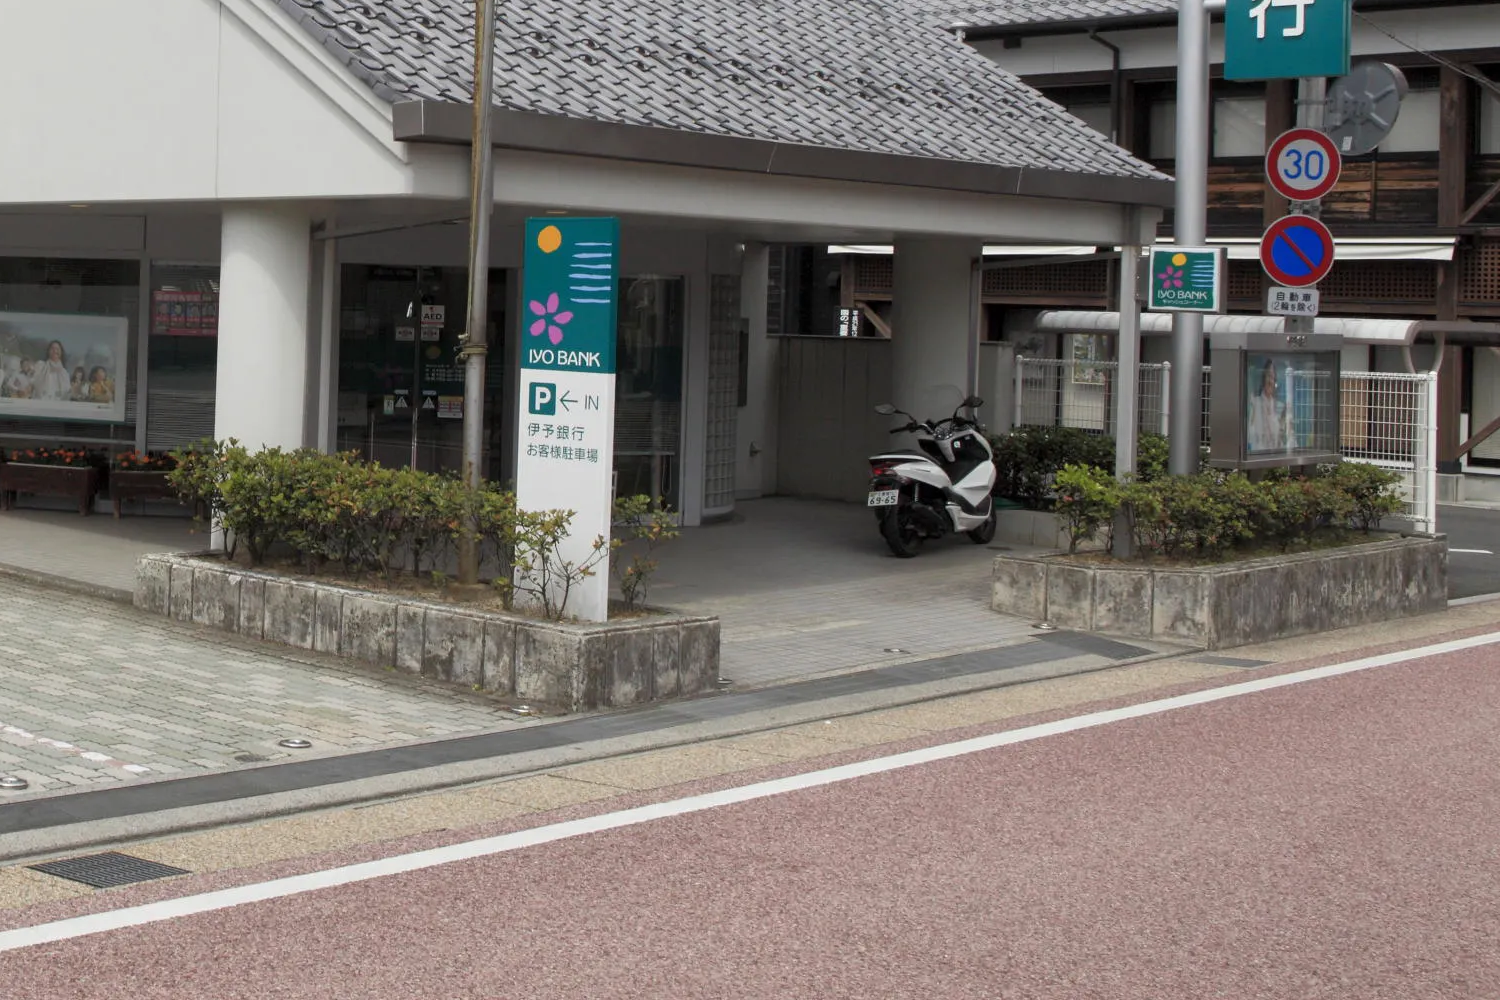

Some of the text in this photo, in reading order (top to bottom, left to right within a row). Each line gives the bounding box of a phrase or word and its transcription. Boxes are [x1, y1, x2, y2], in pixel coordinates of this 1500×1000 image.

[1283, 148, 1324, 181] 30
[1157, 289, 1208, 300] IYO BANK
[1276, 291, 1312, 302] 自動車
[529, 349, 601, 368] IYO BANK
[534, 386, 600, 411] P IN
[527, 422, 585, 442] 伊予銀行
[526, 443, 599, 463] お客様駐車場
